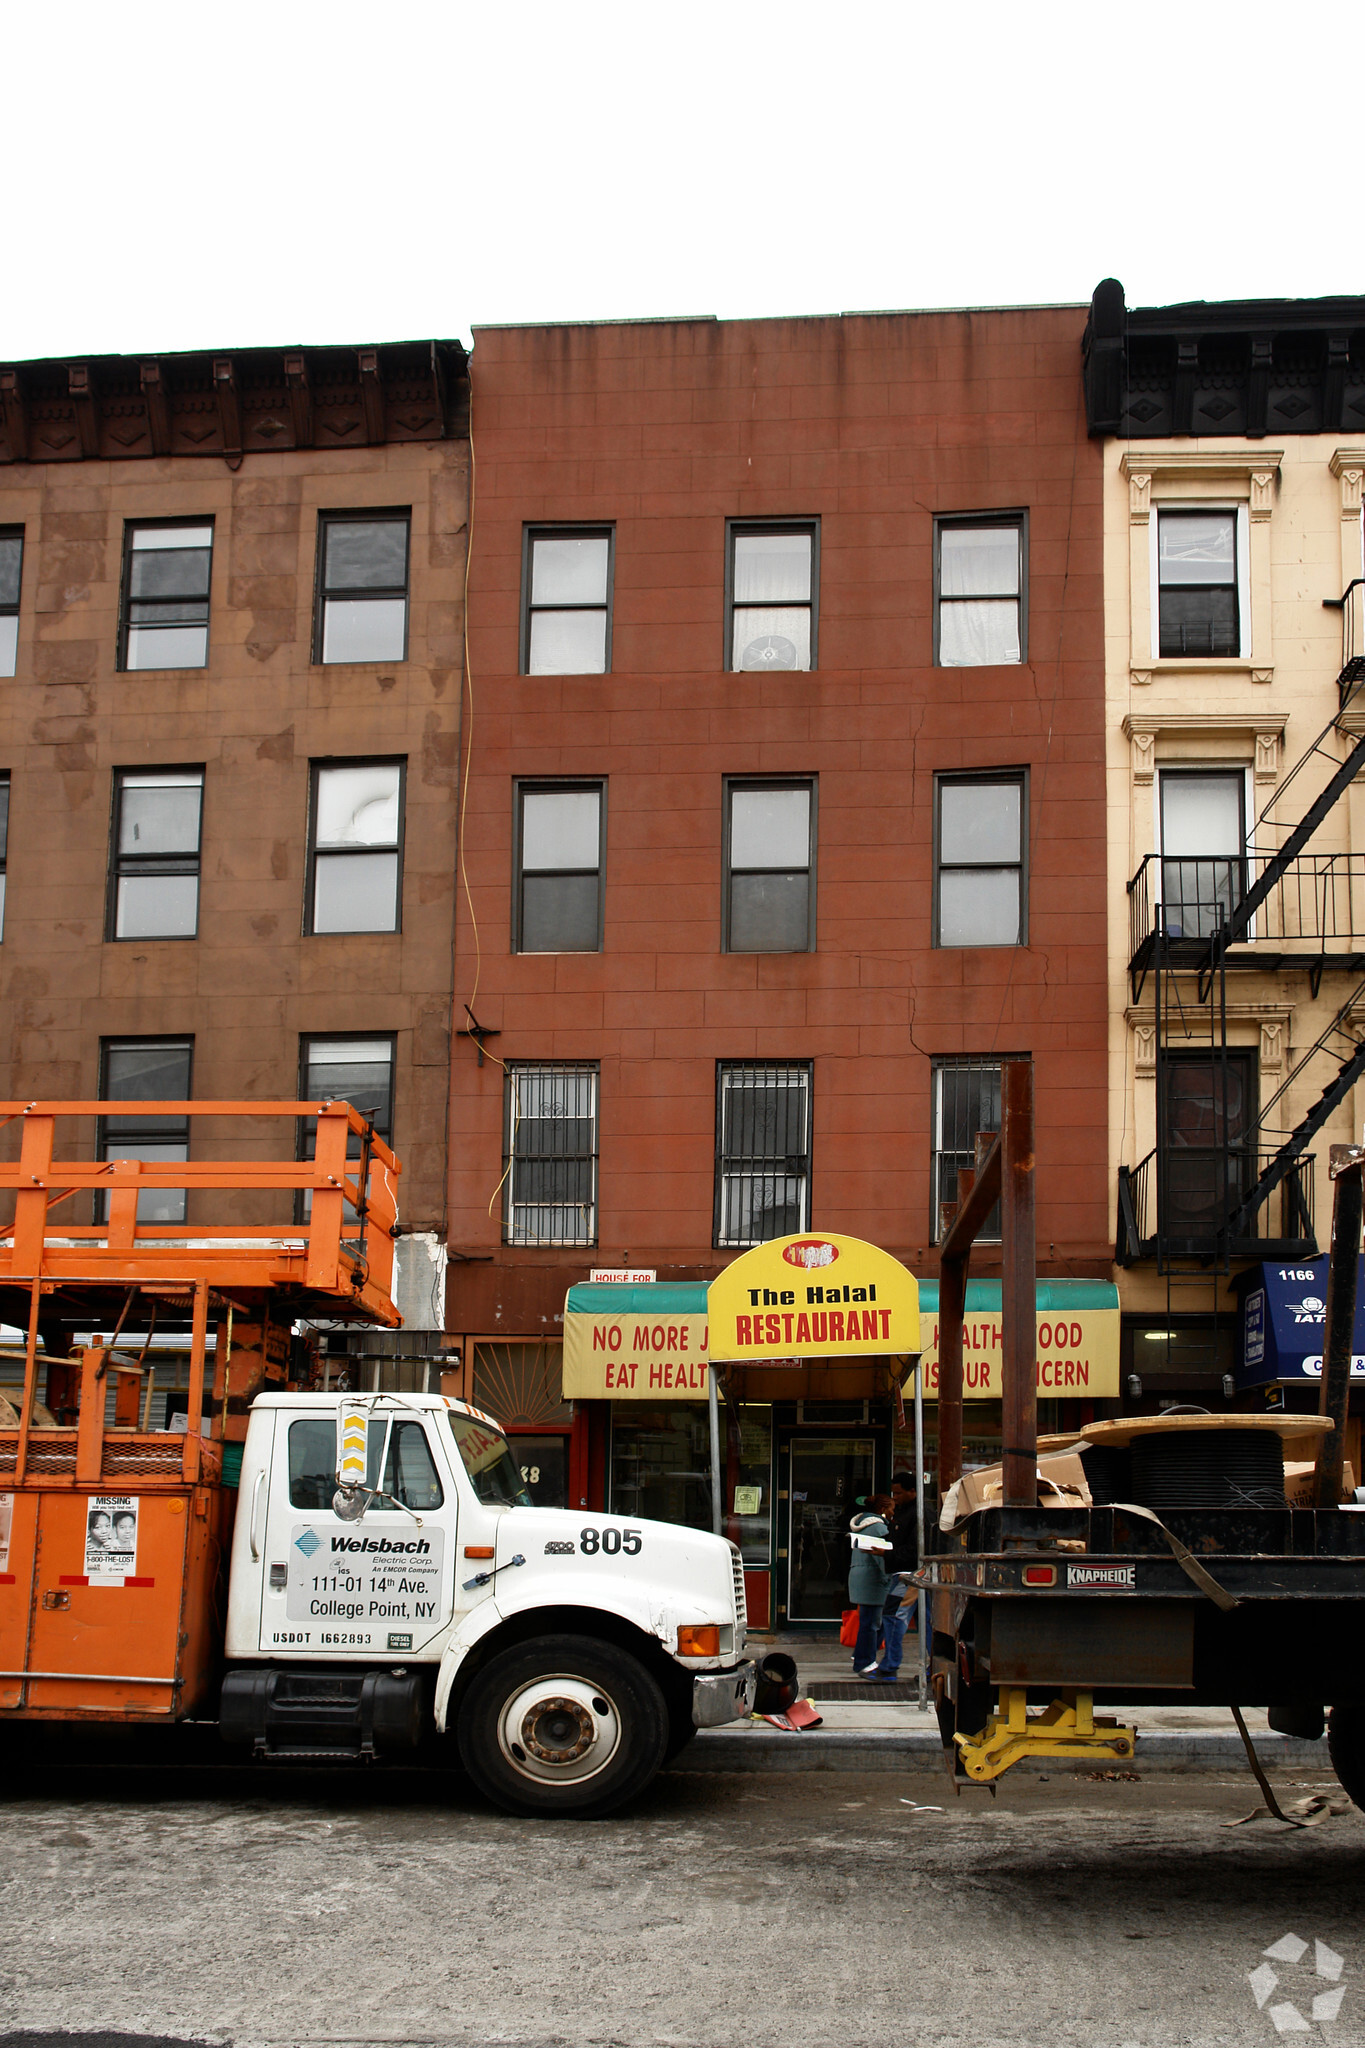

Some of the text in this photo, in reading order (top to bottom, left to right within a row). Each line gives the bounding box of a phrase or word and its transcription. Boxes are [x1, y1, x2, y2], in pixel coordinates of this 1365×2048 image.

[595, 1274, 651, 1282] HOUSE FOR
[1279, 1270, 1315, 1281] 1166
[747, 1284, 877, 1306] The Halal
[736, 1309, 892, 1345] RESTAURANT
[1294, 1314, 1326, 1323] IAT
[593, 1325, 708, 1351] NO MORE J
[933, 1322, 1083, 1350] HALTH OOD
[605, 1363, 708, 1389] EAT HEALT
[961, 1362, 990, 1388] UR
[96, 1497, 131, 1505] MISSING
[331, 1537, 430, 1554] Welsbach
[545, 1541, 575, 1551] 4700
[580, 1528, 642, 1555] 805
[372, 1556, 433, 1566] Electric Corp.
[408, 1567, 439, 1575] Company
[1067, 1567, 1135, 1585] KNAPHEIDE
[312, 1576, 429, 1593] 111-01 14th Ave.
[310, 1600, 436, 1619] College Point, NY
[273, 1633, 372, 1644] USDOT 1662893
